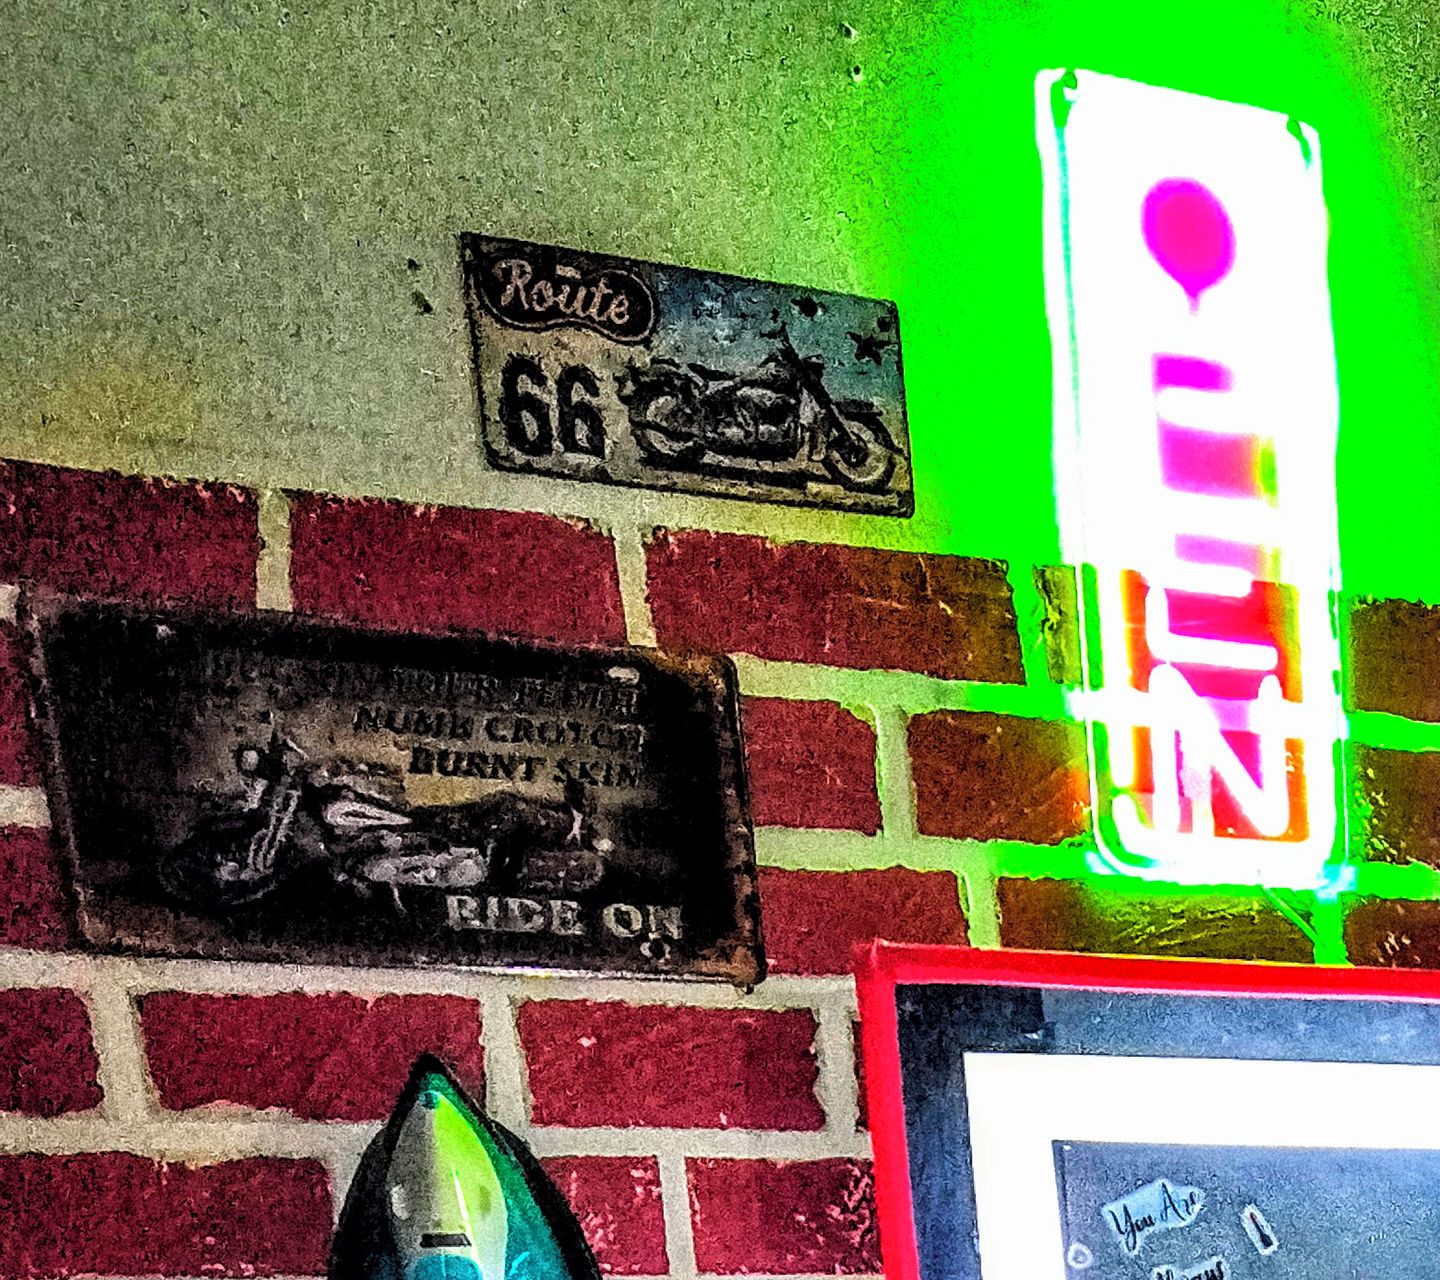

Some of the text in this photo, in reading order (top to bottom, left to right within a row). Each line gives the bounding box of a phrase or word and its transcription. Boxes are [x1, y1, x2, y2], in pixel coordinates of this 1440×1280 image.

[496, 258, 632, 326] Route
[499, 352, 606, 456] 66
[408, 745, 640, 788] BURNT SKIN
[445, 894, 684, 940] RIDE ON
[1108, 1202, 1156, 1251] You
